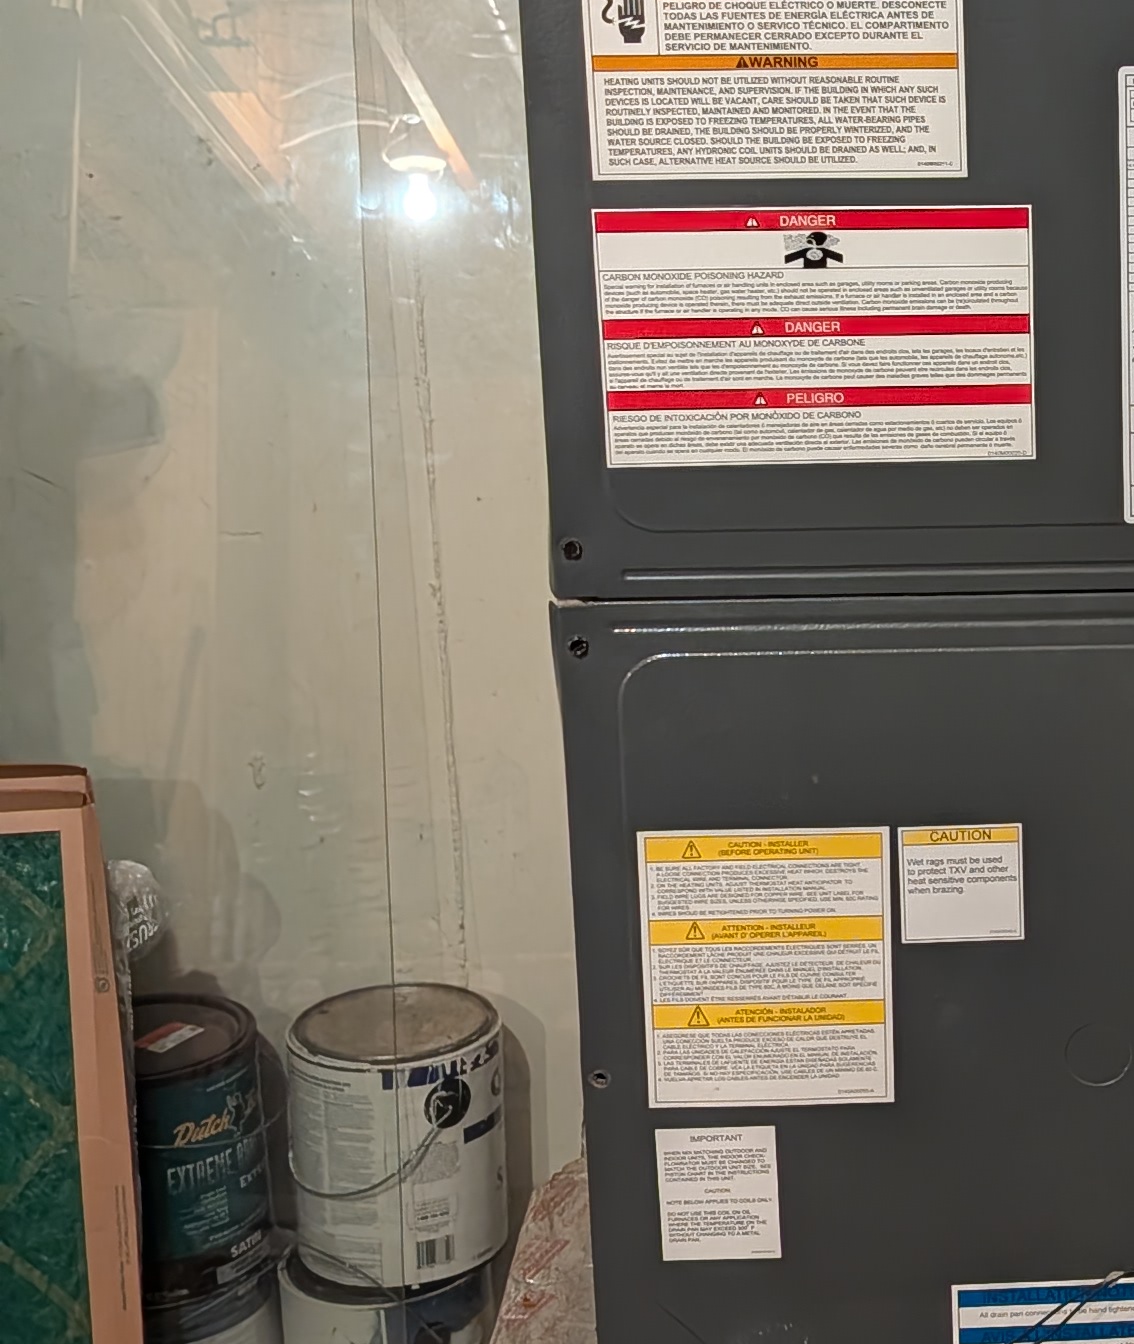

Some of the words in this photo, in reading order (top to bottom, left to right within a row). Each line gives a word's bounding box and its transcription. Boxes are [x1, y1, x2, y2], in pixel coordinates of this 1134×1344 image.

[662, 1, 706, 10] PELIGRO
[708, 1, 722, 10] DE
[724, 1, 767, 10] CHOQUE
[768, 0, 824, 10] ELÉCTRICO
[826, 0, 834, 9] O
[881, 0, 947, 9] DESCONECTE
[663, 12, 697, 20] TODAS
[699, 11, 719, 20] LAS
[721, 11, 766, 20] FUENTES
[768, 11, 782, 20] DE
[829, 10, 884, 20] ELÉCTRICA
[886, 10, 918, 19] ANTES
[920, 10, 935, 19] DE
[663, 22, 745, 31] MANTENIMIENTO
[746, 21, 755, 30] O
[850, 21, 863, 30] EL
[864, 20, 950, 29] COMPARTIMENTO
[664, 32, 691, 41] DEBE
[693, 32, 761, 41] PERMANECER
[763, 31, 812, 40] CERRADO
[814, 31, 860, 40] EXCEPTO
[862, 31, 908, 40] DURANTE
[910, 31, 924, 39] EL
[664, 42, 711, 51] SERVICIO
[713, 42, 726, 51] DE
[749, 56, 819, 70] WARNING
[779, 214, 835, 228] DANGER
[602, 273, 641, 281] CARBON
[642, 272, 692, 281] MONOXIDE
[693, 271, 746, 280] POISONING
[746, 271, 785, 279] HAZARD
[784, 320, 840, 333] DANGER
[606, 341, 641, 350] RISQUE
[642, 340, 737, 350] D'EMPOISONNEMENT
[736, 340, 751, 351] AU
[753, 339, 806, 348] MONOXYDE
[806, 339, 820, 347] DE
[821, 338, 867, 347] CARBONE
[786, 392, 844, 404] PELIGRO
[612, 414, 647, 423] RIESGO
[649, 414, 662, 422] DE
[729, 412, 749, 421] POR
[802, 411, 815, 420] DE
[816, 410, 862, 419] CARBONO
[929, 828, 992, 841] CAUTION
[906, 858, 924, 866] Wet
[925, 858, 944, 867] rags
[945, 857, 967, 865] must
[968, 857, 980, 865] be
[981, 856, 1003, 865] used
[907, 868, 916, 876] to
[917, 868, 946, 876] protect
[947, 865, 968, 875] TXV
[968, 866, 985, 874] and
[986, 865, 1009, 874] other
[907, 877, 926, 885] heat
[927, 876, 965, 885] sensitive
[966, 874, 1018, 883] components
[907, 887, 931, 895] when
[174, 1108, 229, 1146] Dutch
[689, 1134, 743, 1142] IMPORTANT
[167, 1148, 232, 1195] EXTREME
[231, 1229, 262, 1257] SATIN
